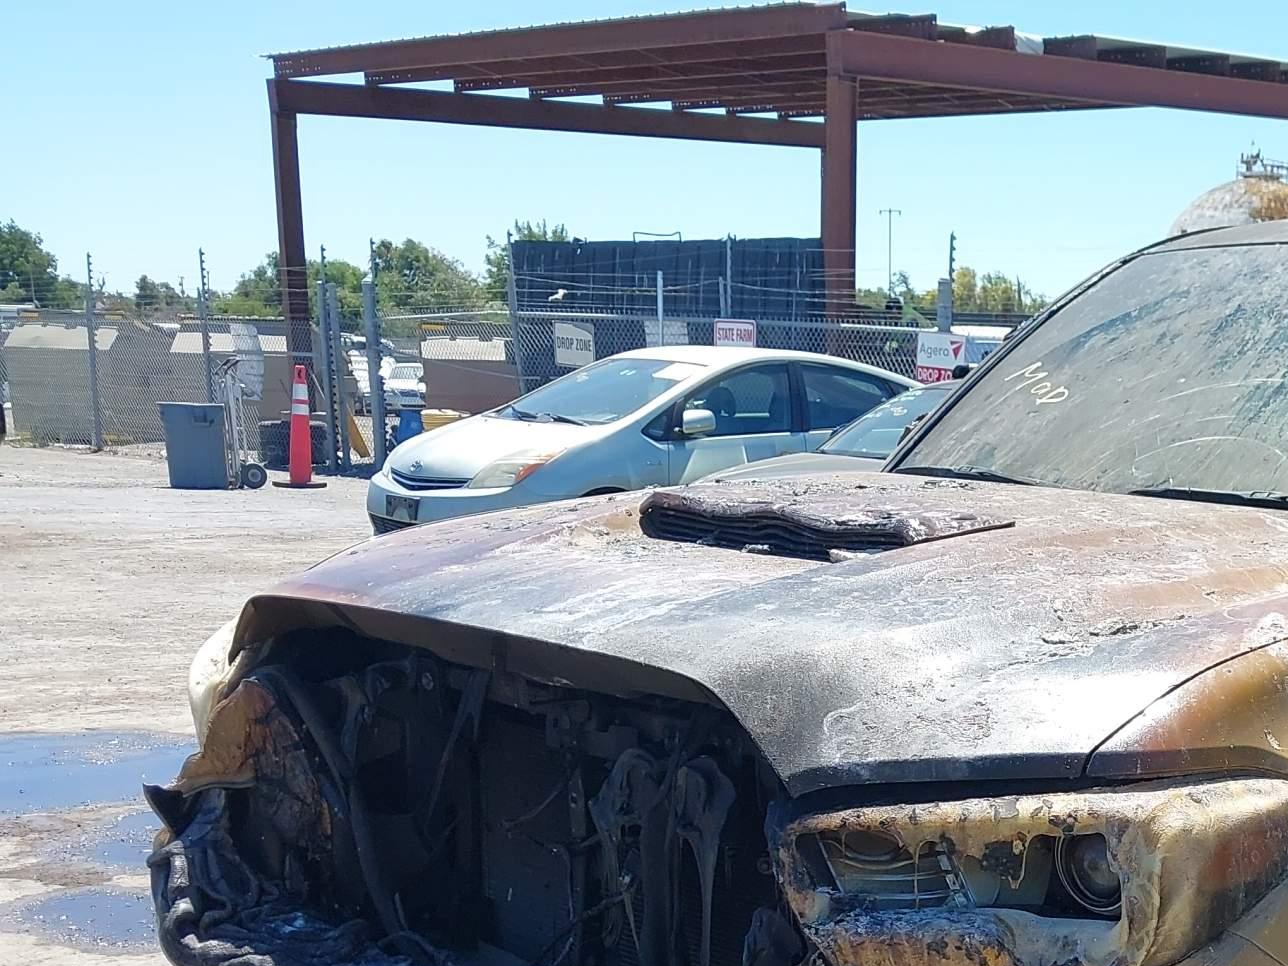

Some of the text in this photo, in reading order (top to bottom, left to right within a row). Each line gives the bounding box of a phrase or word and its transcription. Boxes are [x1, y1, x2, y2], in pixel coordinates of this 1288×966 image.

[717, 327, 753, 343] STATE FARM
[556, 336, 592, 352] DROP ZONE
[919, 342, 950, 358] Agero
[918, 367, 953, 382] DROP ZO
